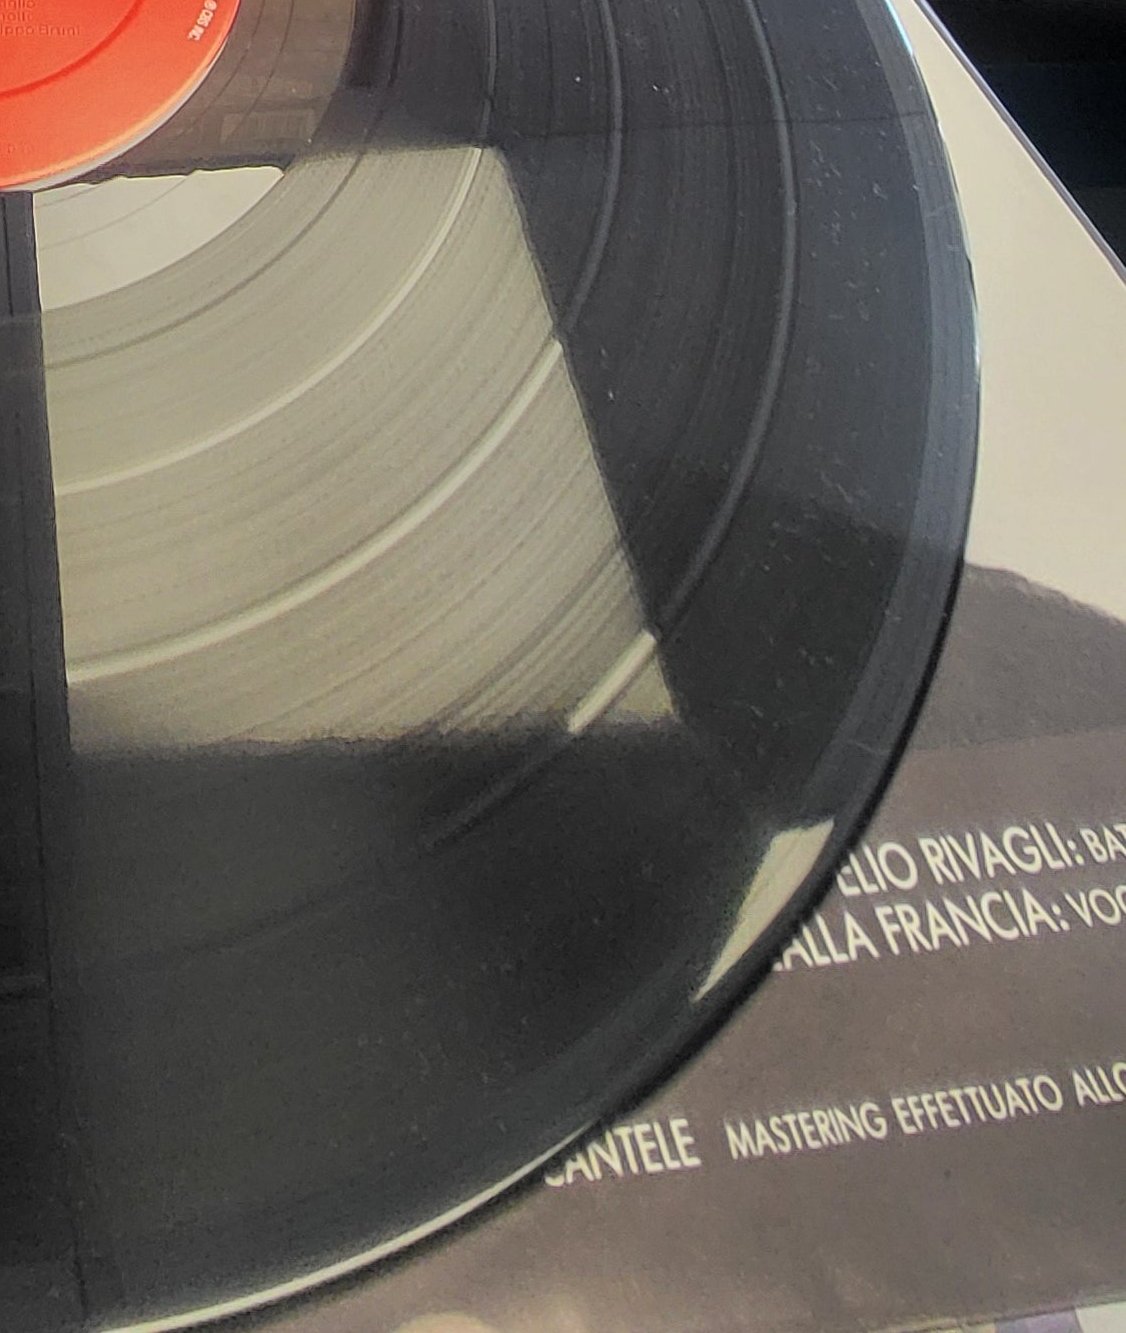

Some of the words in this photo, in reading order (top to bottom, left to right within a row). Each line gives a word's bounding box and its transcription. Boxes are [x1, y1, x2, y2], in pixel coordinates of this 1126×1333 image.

[918, 821, 1085, 888] RIVAGLI:
[773, 909, 881, 972] ALLA
[874, 888, 1071, 958] FRANCIA:
[544, 1117, 702, 1187] ANTELE
[724, 1104, 887, 1162] MASTERING
[892, 1073, 1064, 1135] EFFETTUATO
